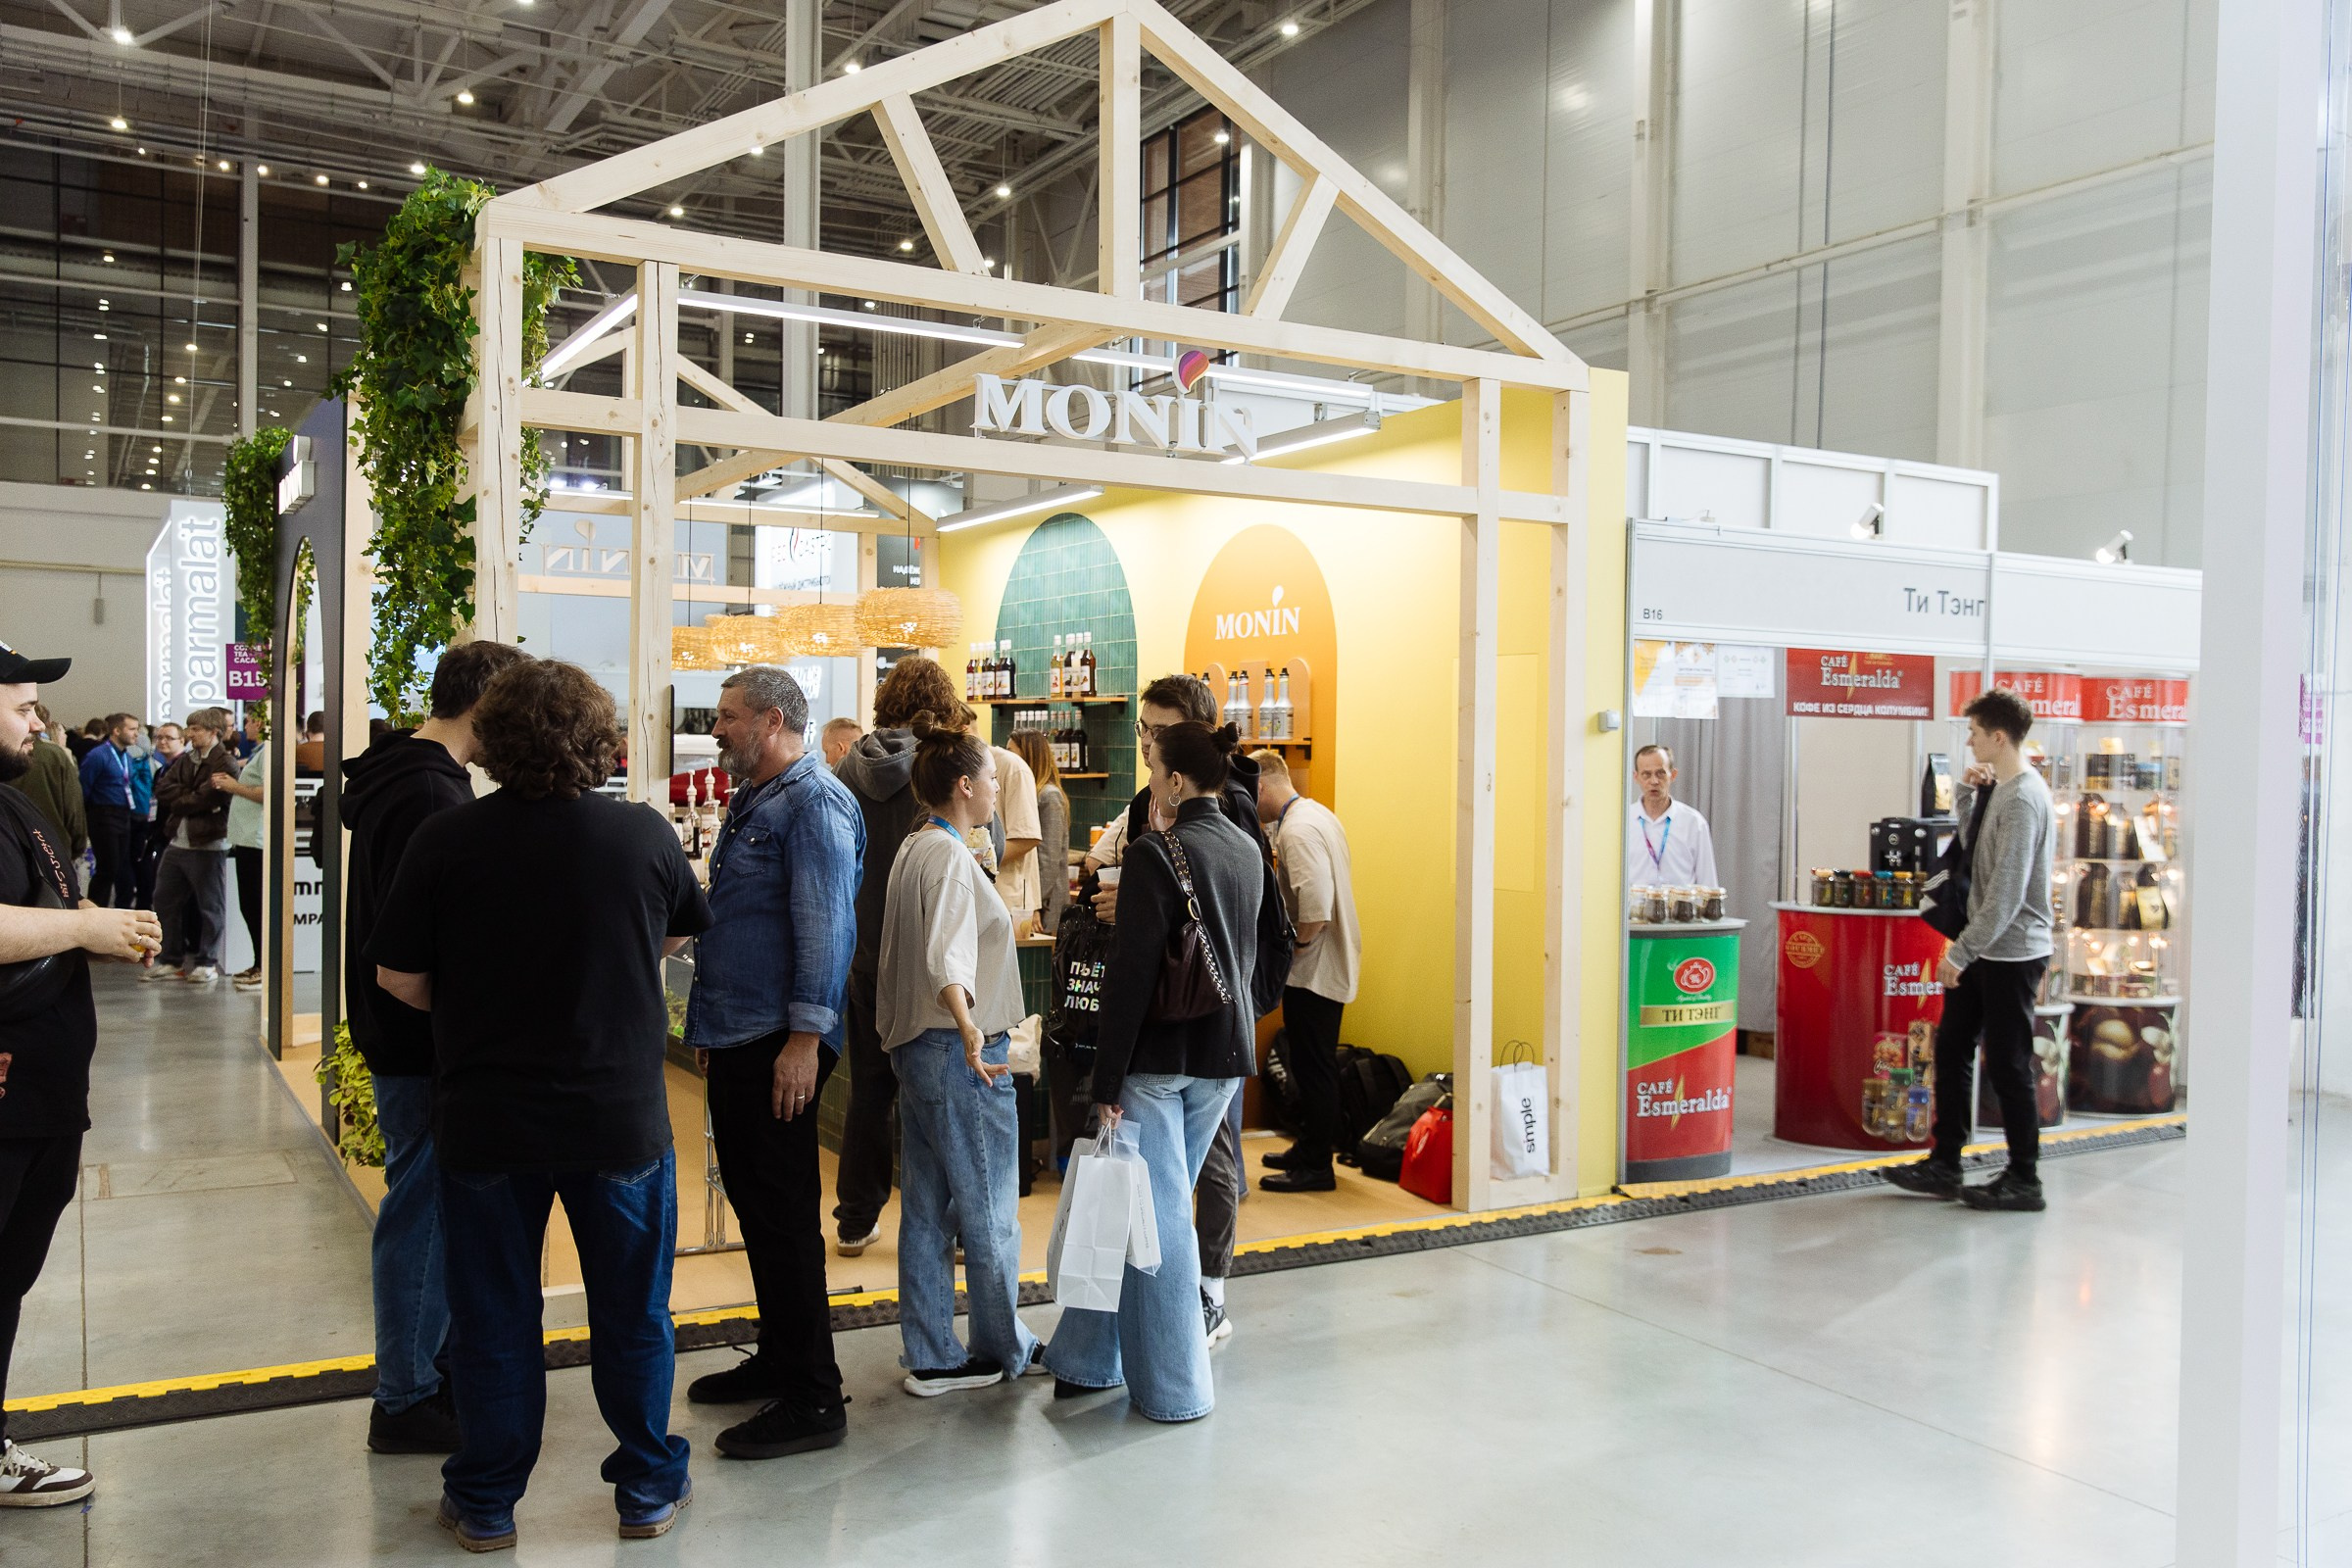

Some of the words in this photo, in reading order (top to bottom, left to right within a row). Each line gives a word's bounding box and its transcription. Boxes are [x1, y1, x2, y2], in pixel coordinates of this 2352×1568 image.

[969, 372, 1258, 458] MONIN
[180, 516, 225, 705] parmalat
[1904, 588, 1929, 613] Ти
[1937, 590, 1985, 617] Тэнг
[1214, 607, 1301, 640] MONIN
[1642, 609, 1663, 620] B16
[1821, 655, 1848, 667] CAFÉ
[1820, 667, 1900, 689] Esmeralda
[1995, 676, 2045, 694] CAFÉ
[2106, 683, 2153, 699] CAFÉ
[1792, 702, 1821, 712] КОФЕ
[1822, 703, 1836, 713] ИЗ
[1837, 703, 1873, 716] СЕРДЦА
[2031, 694, 2080, 717] meral
[1884, 961, 1920, 976] CAFÉ
[1066, 978, 1102, 994] ЗНАЧ
[1884, 976, 1943, 997] Esmer
[1063, 995, 1100, 1011] ЛЮБ
[1662, 1008, 1683, 1022] ТИ
[1686, 1006, 1721, 1020] ТЭНГ
[1637, 1079, 1674, 1096] CAFÉ
[1637, 1088, 1730, 1118] Esmeralda
[1521, 1098, 1537, 1153] simple
